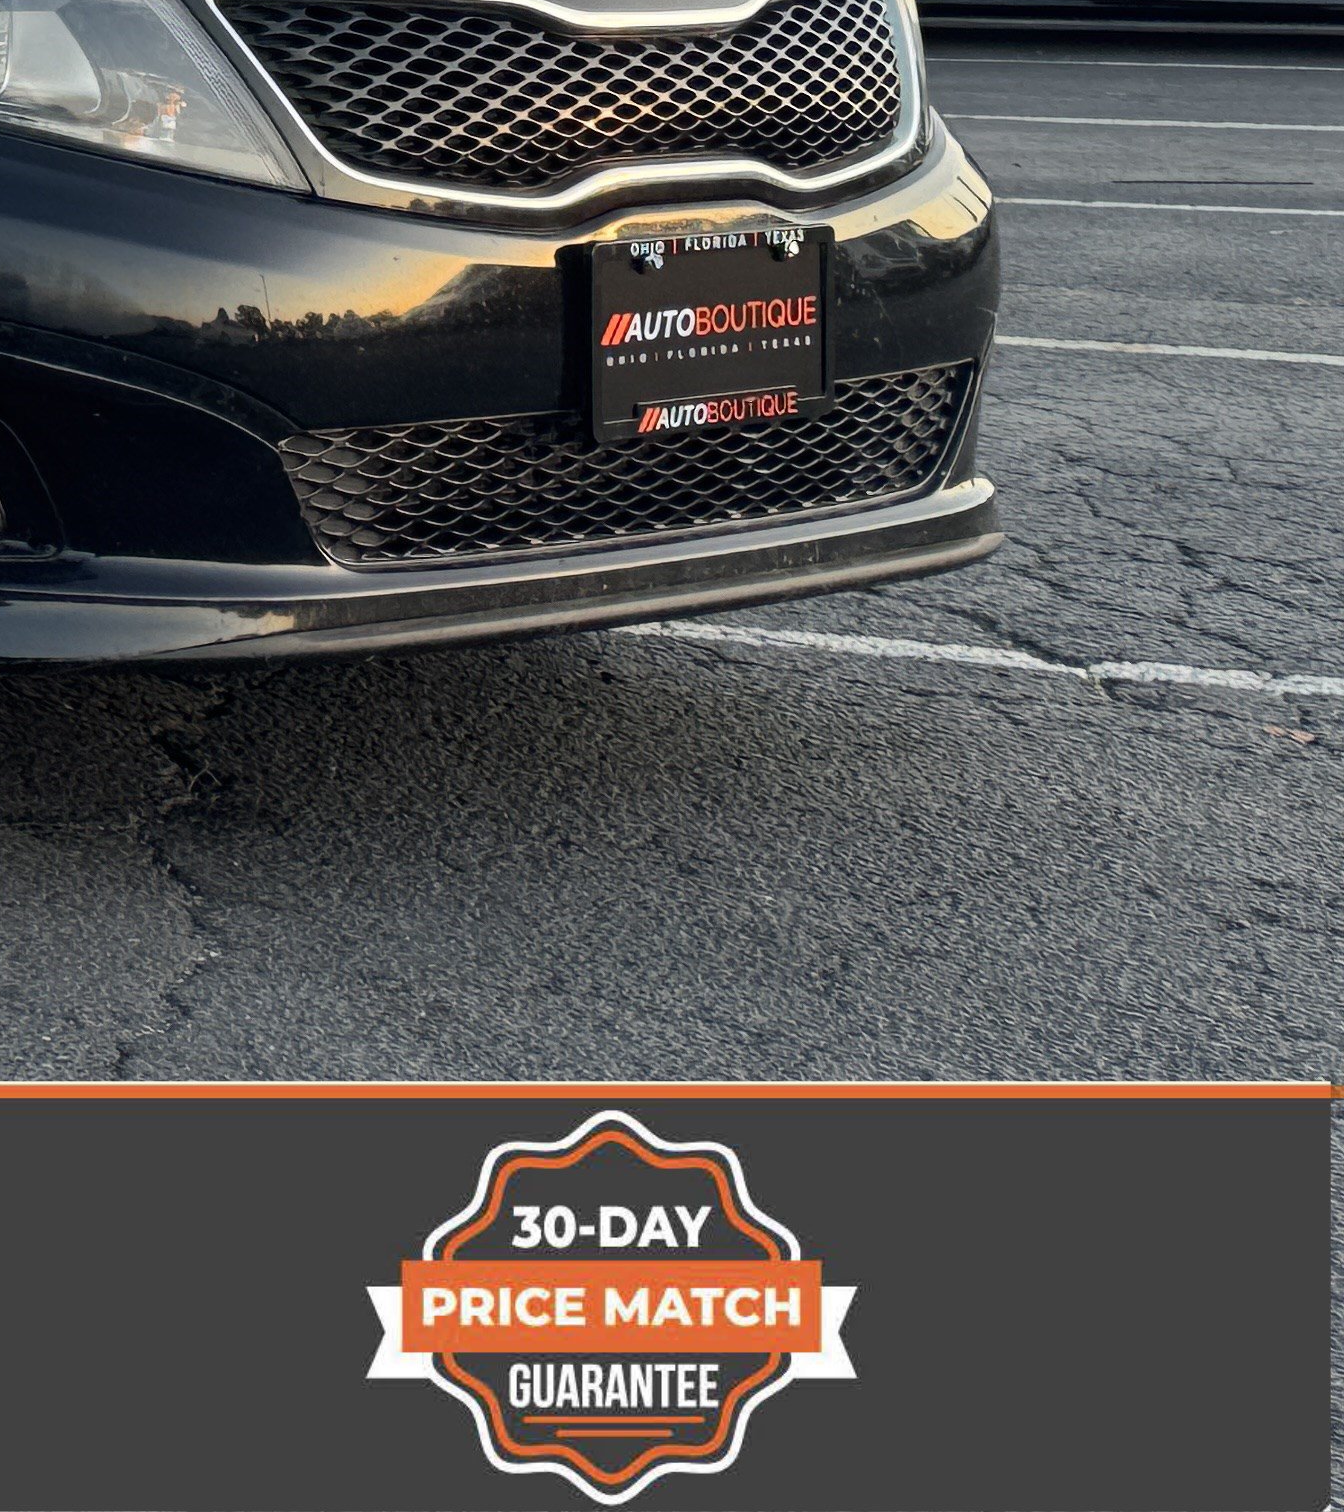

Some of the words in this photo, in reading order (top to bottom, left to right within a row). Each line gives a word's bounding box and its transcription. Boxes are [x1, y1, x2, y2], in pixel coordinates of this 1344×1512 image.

[630, 240, 665, 257] OHIO
[684, 233, 747, 252] FLORIDA
[623, 295, 817, 343] AUTOBOUTIQUE
[654, 391, 800, 431] AUTOBOUTIQUE
